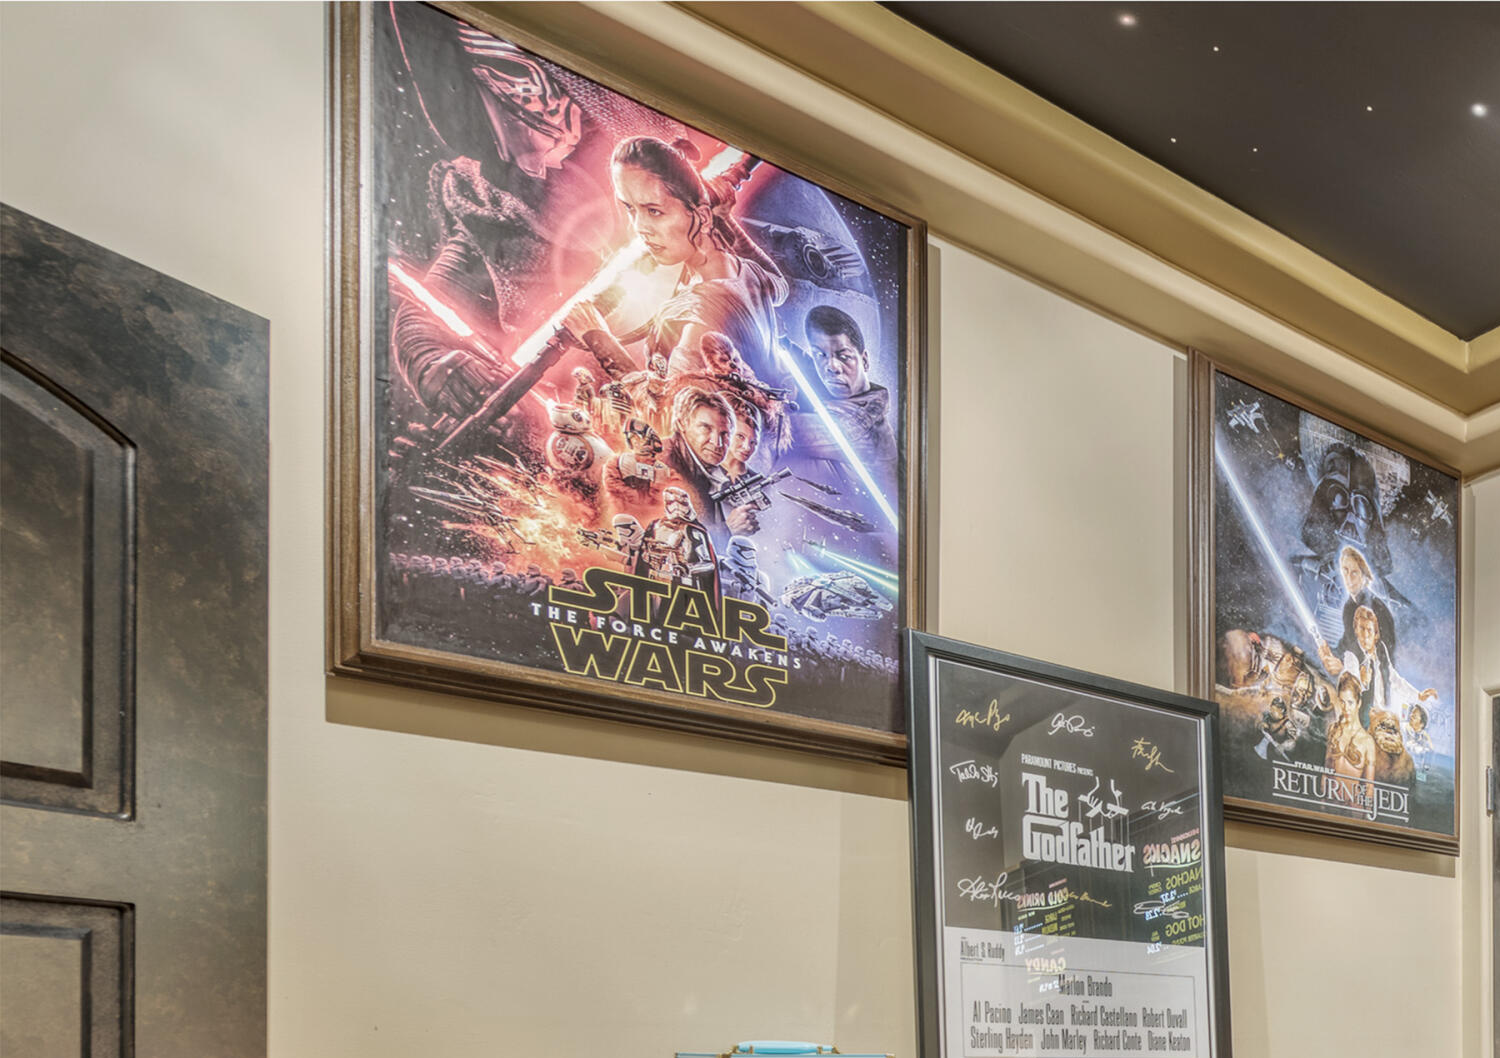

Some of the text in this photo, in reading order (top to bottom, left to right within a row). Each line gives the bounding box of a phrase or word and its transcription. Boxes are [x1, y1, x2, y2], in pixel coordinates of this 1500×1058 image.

[531, 602, 801, 669] THE FORCE AWAKENS
[549, 566, 788, 652] STAR
[550, 622, 788, 708] WARS
[1021, 772, 1069, 818] The
[1273, 767, 1409, 821] RETURN JEDI
[1357, 794, 1374, 808] THE
[1022, 814, 1135, 873] Godfather
[973, 1000, 981, 1022] Al
[984, 1001, 1012, 1024] Pacino
[1018, 1002, 1044, 1025] James
[970, 1026, 1003, 1054] Sterling
[1040, 1028, 1060, 1050] John
